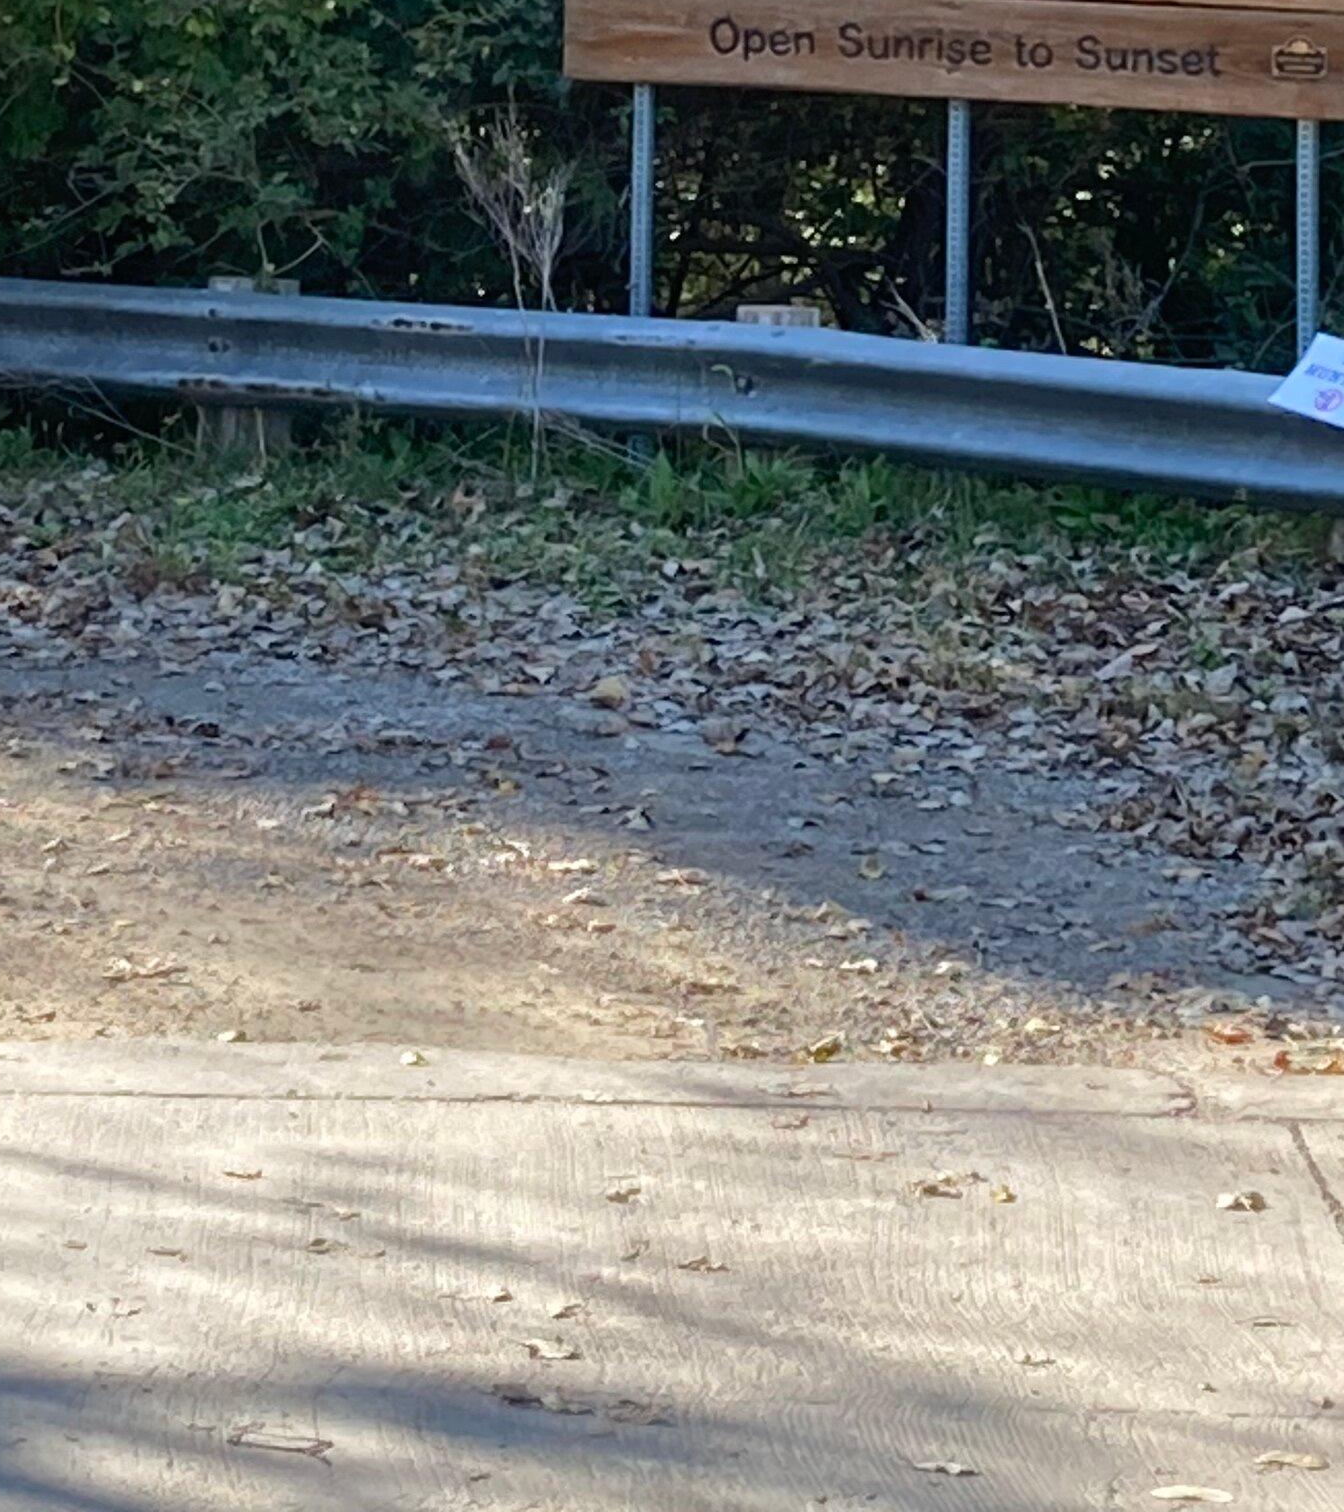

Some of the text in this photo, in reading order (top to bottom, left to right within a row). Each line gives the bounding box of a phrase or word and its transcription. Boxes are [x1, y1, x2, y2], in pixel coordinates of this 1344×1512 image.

[709, 14, 1222, 78] Open Sunrise to Sunset
